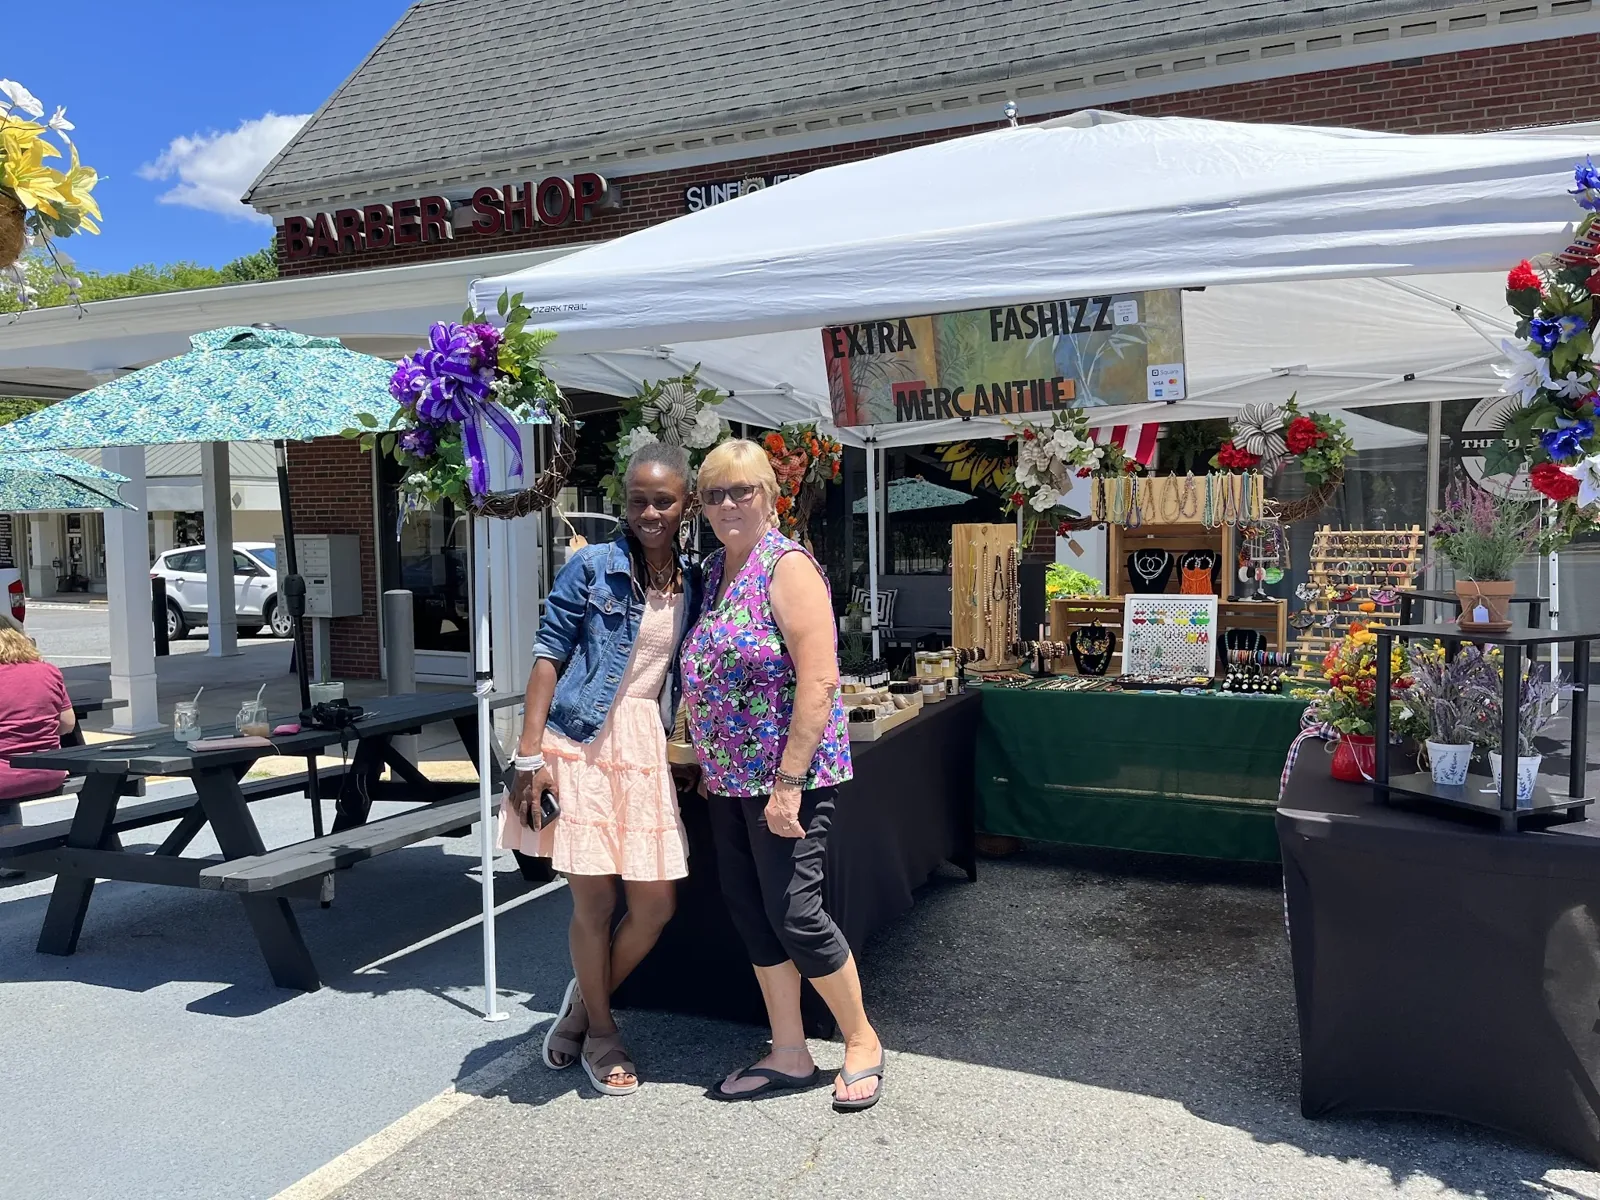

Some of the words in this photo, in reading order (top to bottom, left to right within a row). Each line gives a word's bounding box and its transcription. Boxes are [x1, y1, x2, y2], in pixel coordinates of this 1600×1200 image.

[284, 195, 453, 259] BARBER
[472, 172, 608, 236] SHOP
[831, 318, 917, 358] EXTRA
[989, 296, 1114, 342] FASHIZZ
[895, 376, 1067, 422] MERCANTILE
